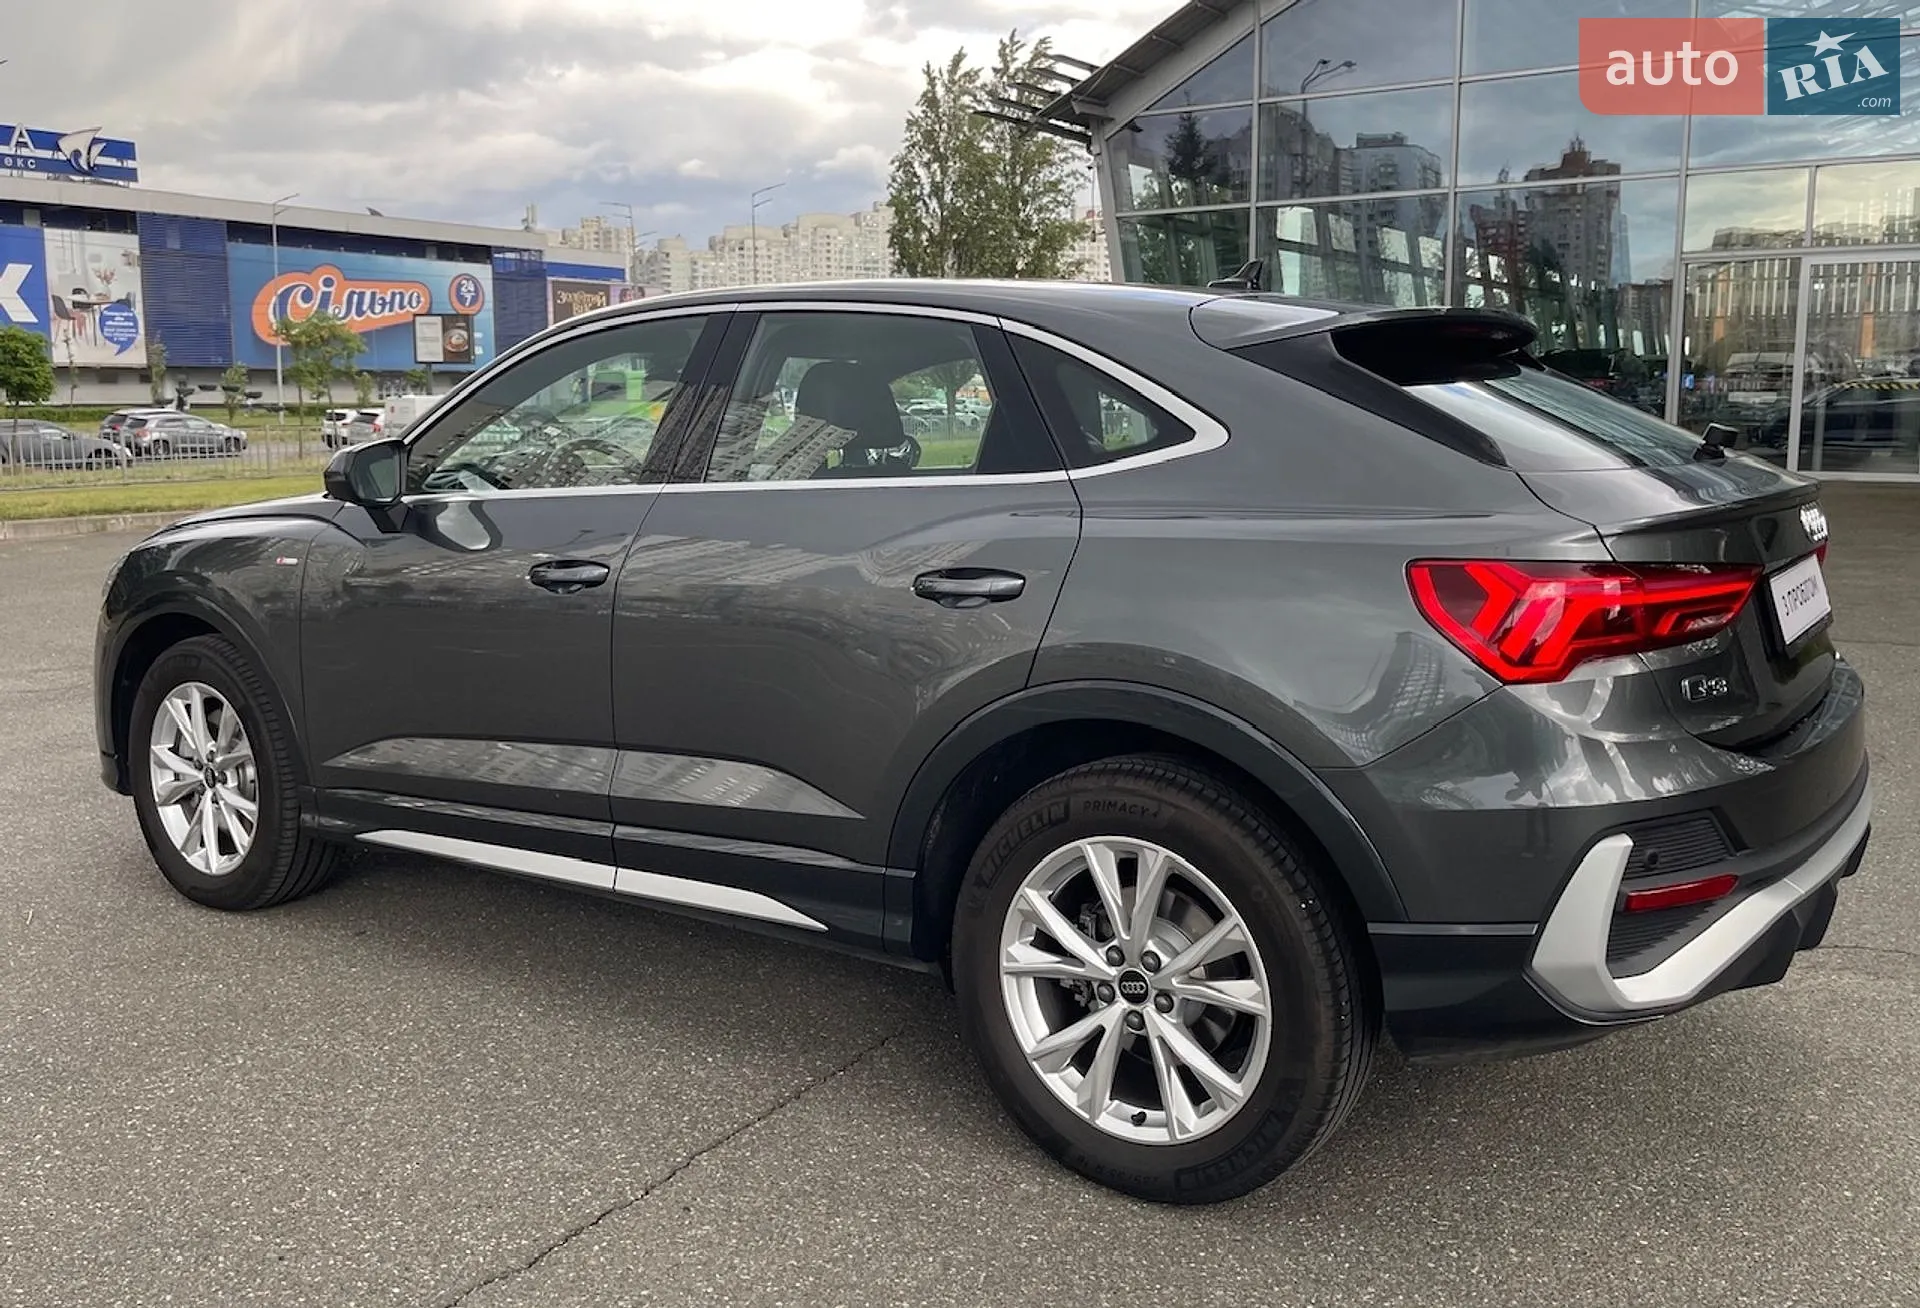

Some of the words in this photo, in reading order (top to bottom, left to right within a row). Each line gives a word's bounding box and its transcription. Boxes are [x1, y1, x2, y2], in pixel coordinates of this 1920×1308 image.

[268, 274, 424, 324] Сільпо
[1083, 800, 1149, 817] PRIMACY
[981, 799, 1071, 887] MICHELIN
